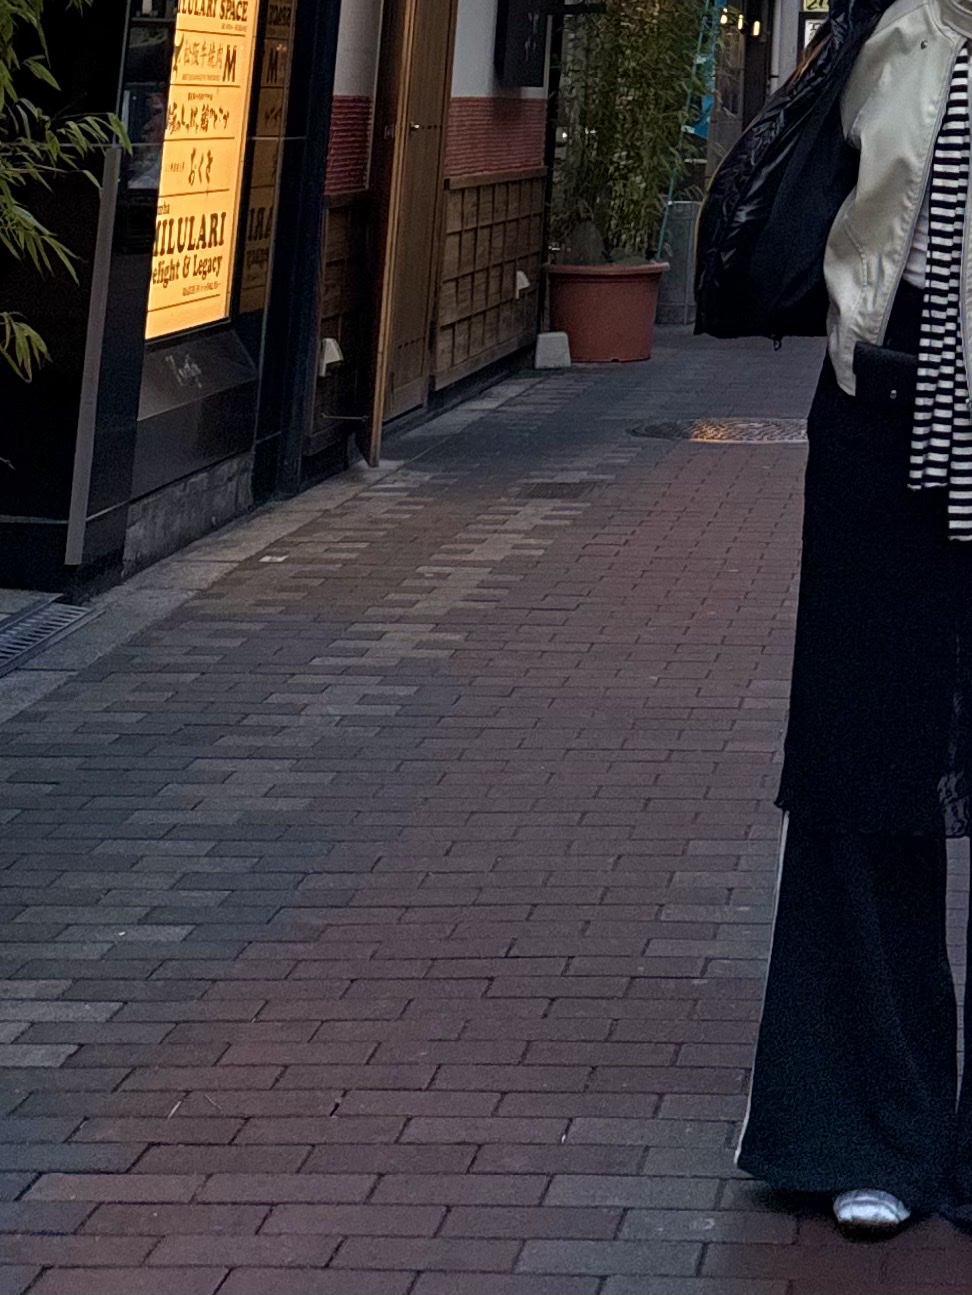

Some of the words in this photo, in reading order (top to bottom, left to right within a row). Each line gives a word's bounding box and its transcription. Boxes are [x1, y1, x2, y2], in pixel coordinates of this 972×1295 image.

[222, 44, 238, 83] M
[182, 255, 191, 279] &
[193, 253, 223, 280] Legacy
